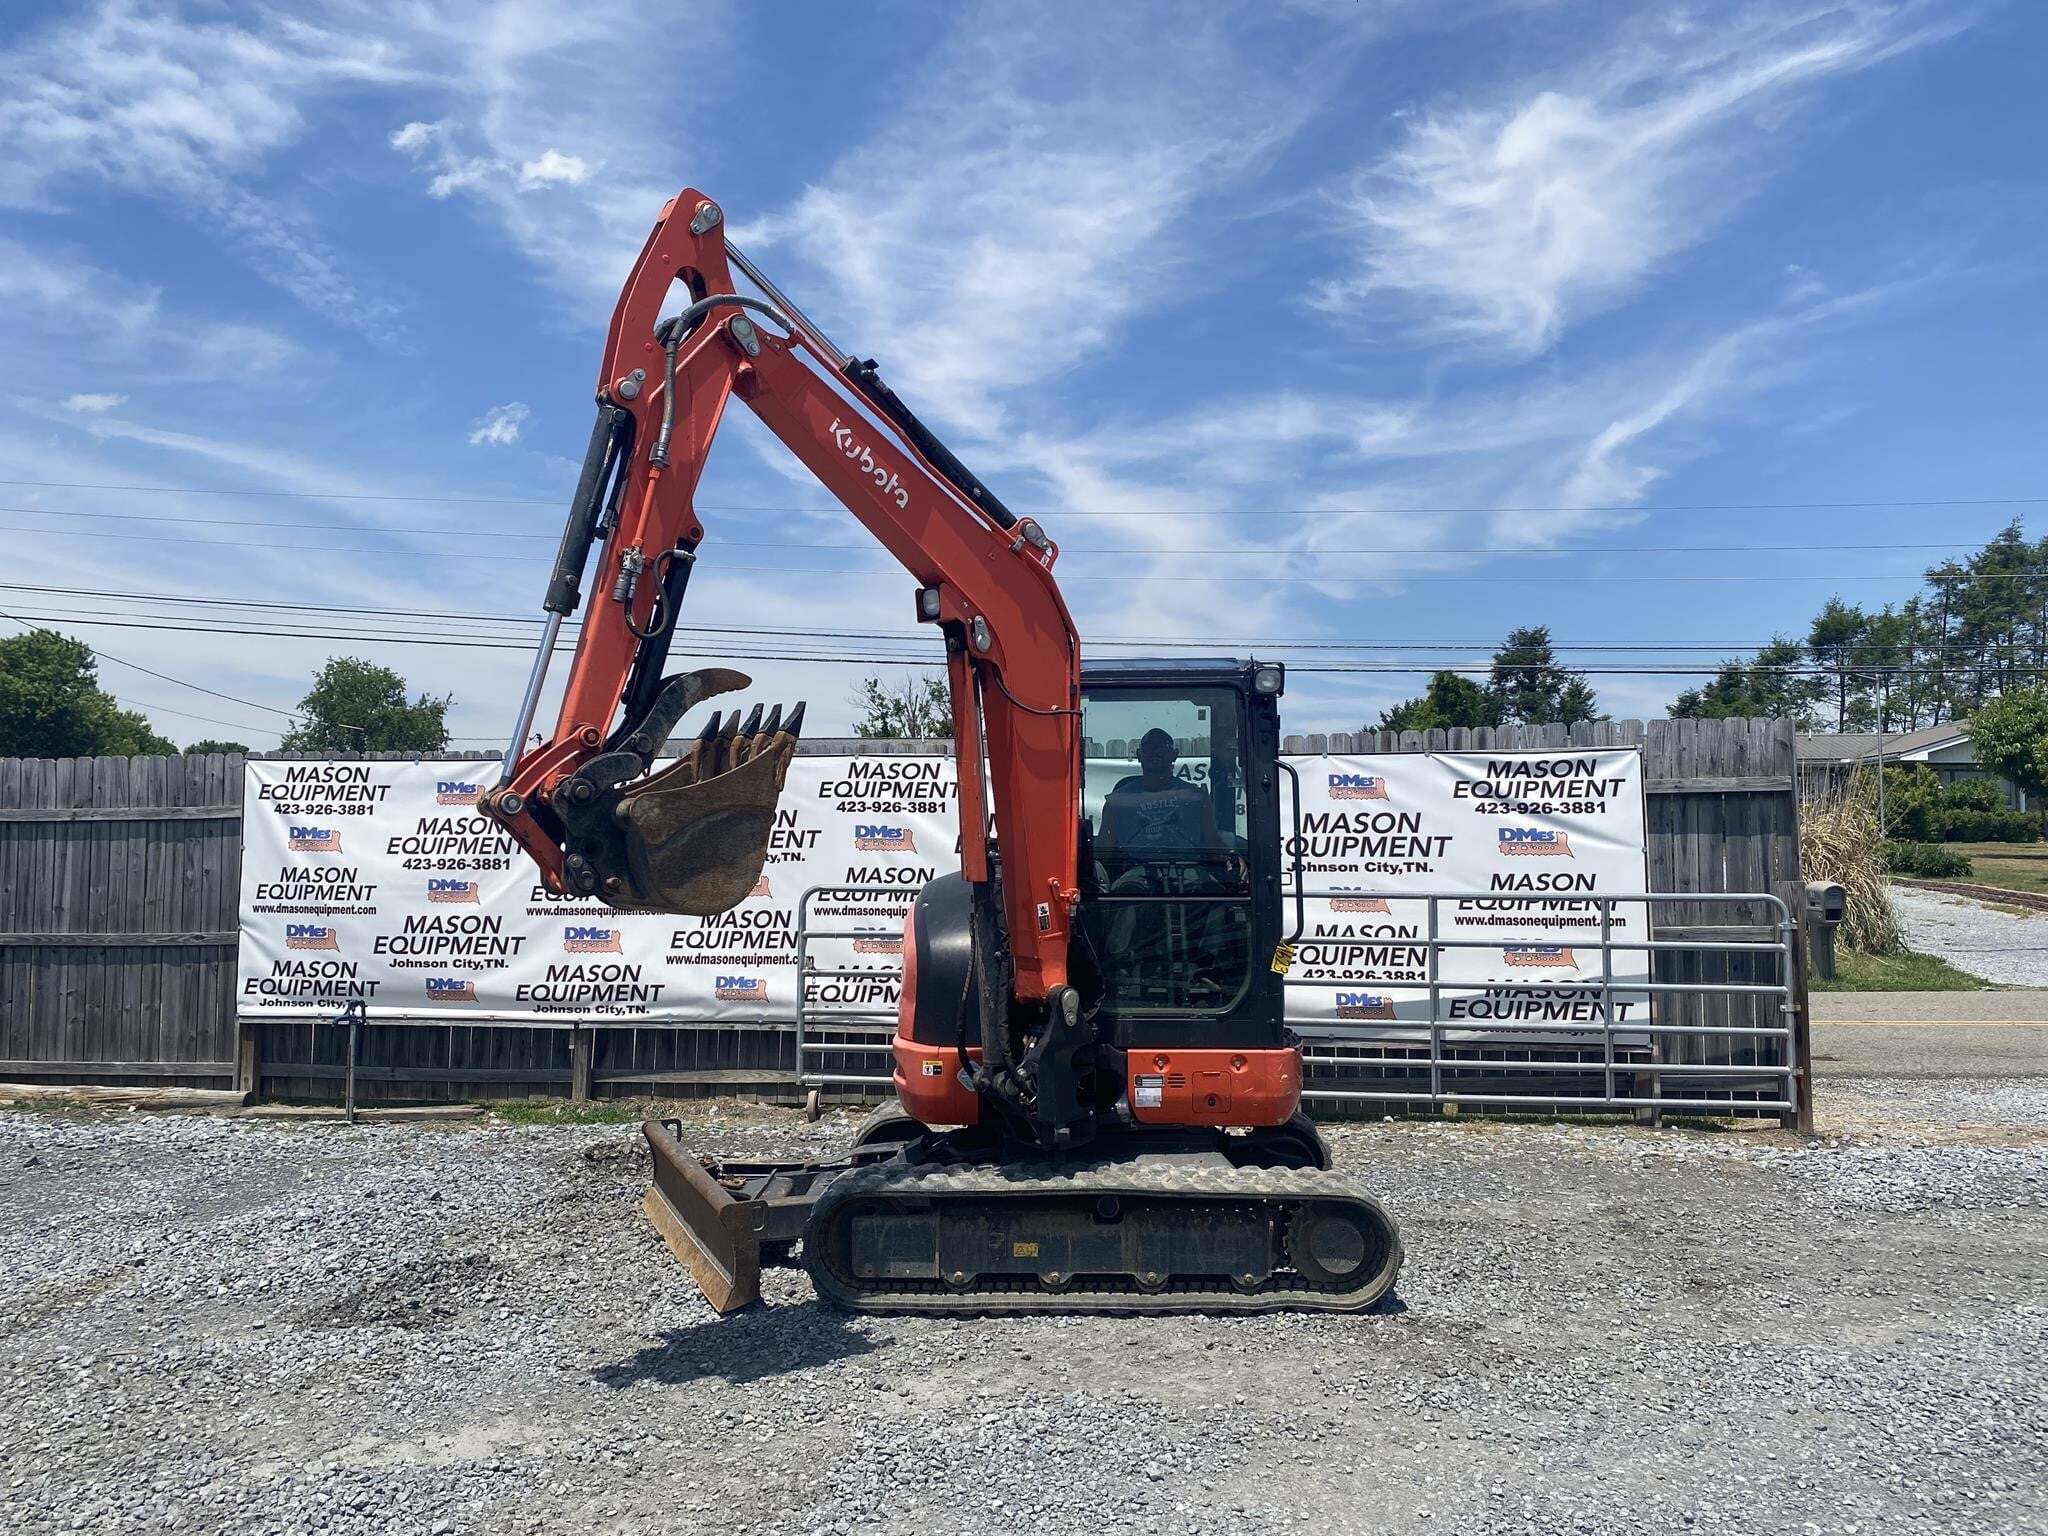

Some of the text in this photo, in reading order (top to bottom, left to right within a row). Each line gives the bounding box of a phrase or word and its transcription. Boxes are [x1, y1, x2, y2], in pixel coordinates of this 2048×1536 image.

[829, 417, 909, 509] Kubota
[286, 766, 371, 784] MASON
[847, 762, 941, 780] MASON
[1487, 759, 1597, 779] MASON
[258, 784, 392, 802] EQUIPMENT
[819, 781, 958, 799] EQUIPMENT
[1453, 778, 1626, 800] EQUIPMENT
[274, 803, 375, 816] 423-926-3881
[836, 801, 946, 814] 423-926-3881
[1475, 801, 1607, 815] 423-926-3881
[416, 817, 504, 835] MASON
[1303, 812, 1422, 835] MASON
[1280, 836, 1453, 858] QUIPMENT
[402, 857, 511, 871] 423-926-3881
[766, 851, 806, 864] ty,TN.
[280, 866, 358, 884] MASON
[846, 867, 936, 885] MASON
[1365, 860, 1434, 876] City,TN.
[1490, 873, 1596, 892] MASON
[256, 883, 377, 901] EQUIPMENT
[252, 903, 377, 916] www.dmasonequipment.com
[814, 905, 909, 919] www.dmasonequip
[403, 915, 502, 935] MASON
[700, 910, 792, 929] MASON
[1455, 914, 1627, 929] www.dmasonequipment.om
[373, 935, 526, 956] EQUIPMENT
[671, 930, 799, 949] EQUIPMEN
[389, 957, 510, 972] Johnson City,TN.
[666, 952, 815, 968] www.dmasonequipment.cm
[1290, 944, 1445, 967] QUIPMEN
[271, 959, 358, 979] MASON
[546, 964, 642, 983] MASON
[1303, 969, 1426, 980] 423-926-3881
[243, 977, 380, 997] EQUIPMENT
[515, 983, 665, 1003] EQUIPMENT
[804, 983, 901, 1004] EQUIPM
[259, 998, 349, 1010] Johnson City,
[533, 1004, 650, 1016] Johnson City,TN.
[1449, 999, 1635, 1022] EQUIPMENT
